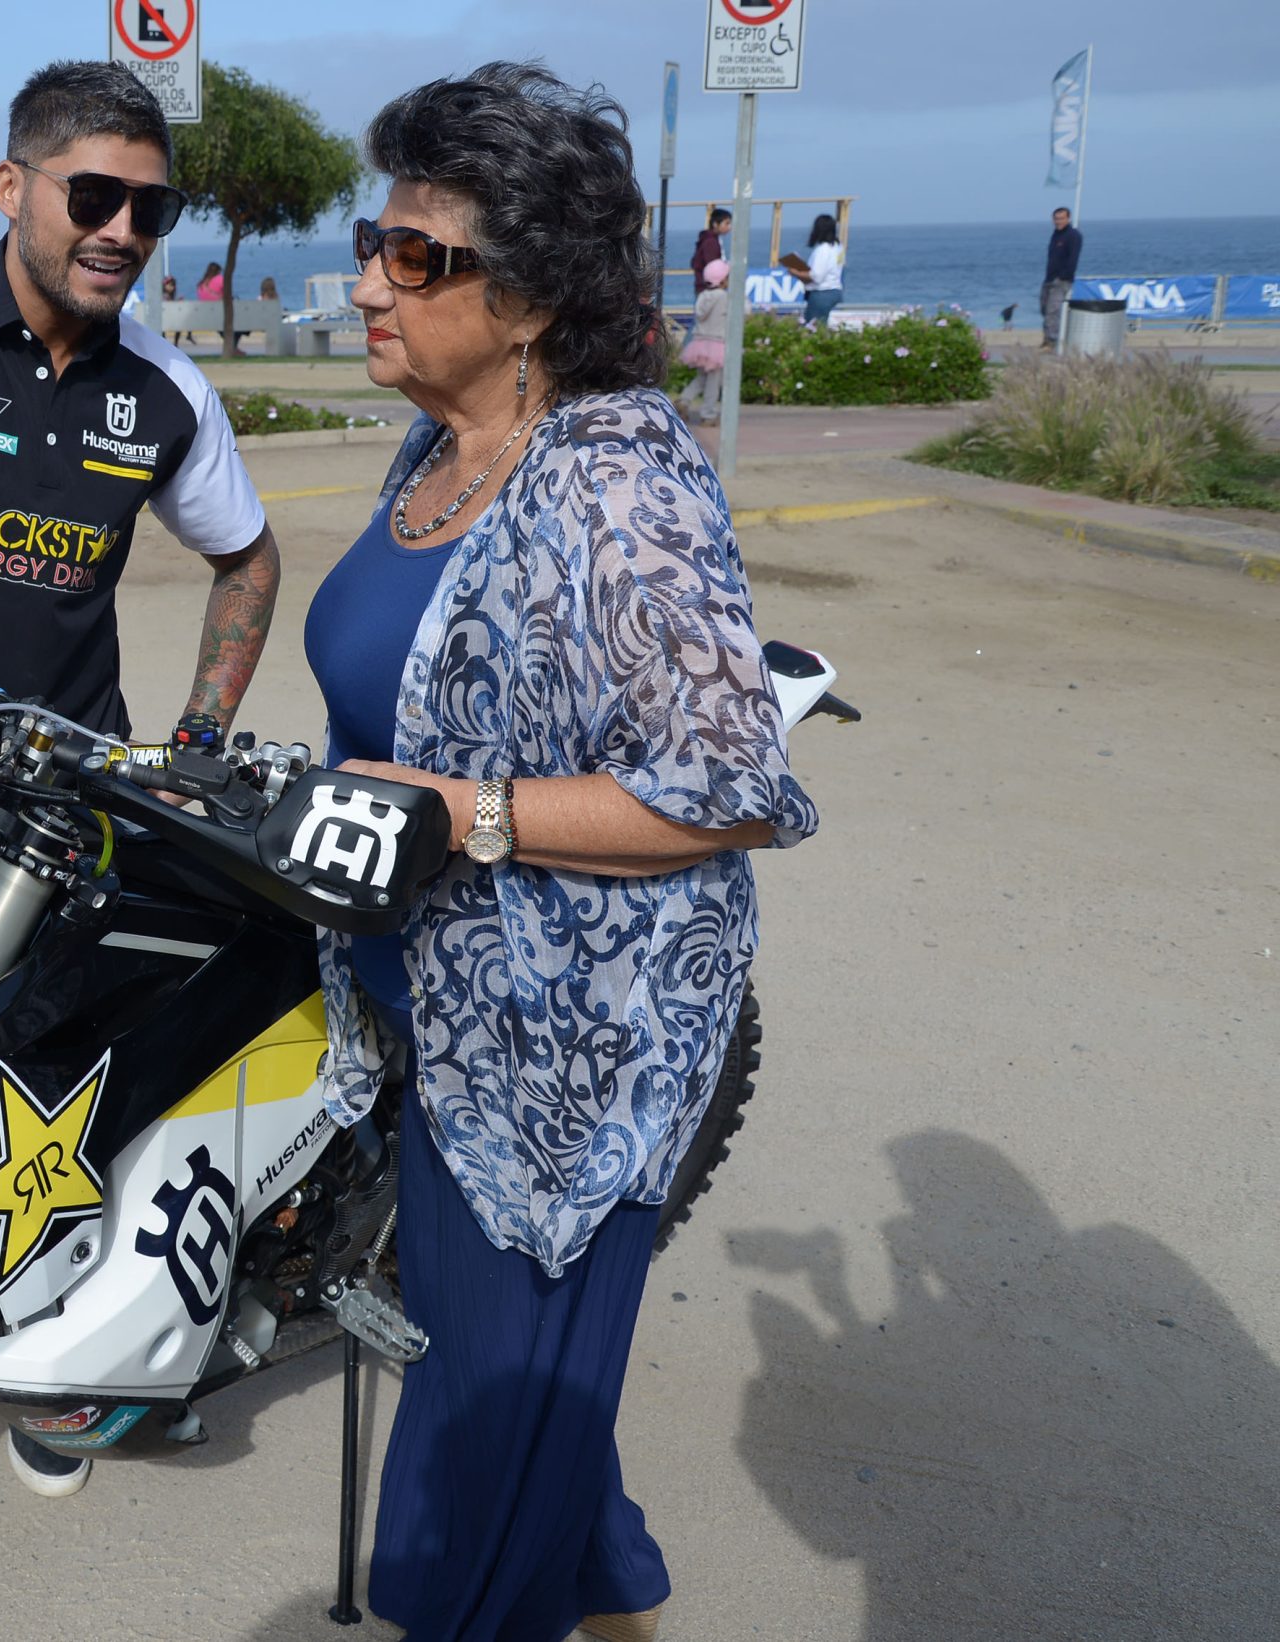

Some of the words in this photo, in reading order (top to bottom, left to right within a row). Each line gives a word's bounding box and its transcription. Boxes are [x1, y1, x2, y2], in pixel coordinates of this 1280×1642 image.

[714, 26, 767, 40] EXCEPTO
[740, 42, 767, 53] CUPO
[718, 55, 733, 64] CON
[734, 55, 775, 64] CREDENCIAL
[128, 60, 180, 74] EXCEPTO
[717, 66, 749, 74] REGISTRO
[751, 66, 784, 74] NACIONAL
[144, 74, 176, 87] CUPO
[717, 77, 726, 85] DE
[727, 77, 736, 85] LA
[737, 76, 786, 85] DISCAPACIDAD
[82, 429, 158, 459] Husqvarna
[118, 456, 139, 464] FACTORY
[139, 458, 156, 466] RACING
[178, 777, 201, 789] brembo
[255, 1107, 329, 1196] Husqva
